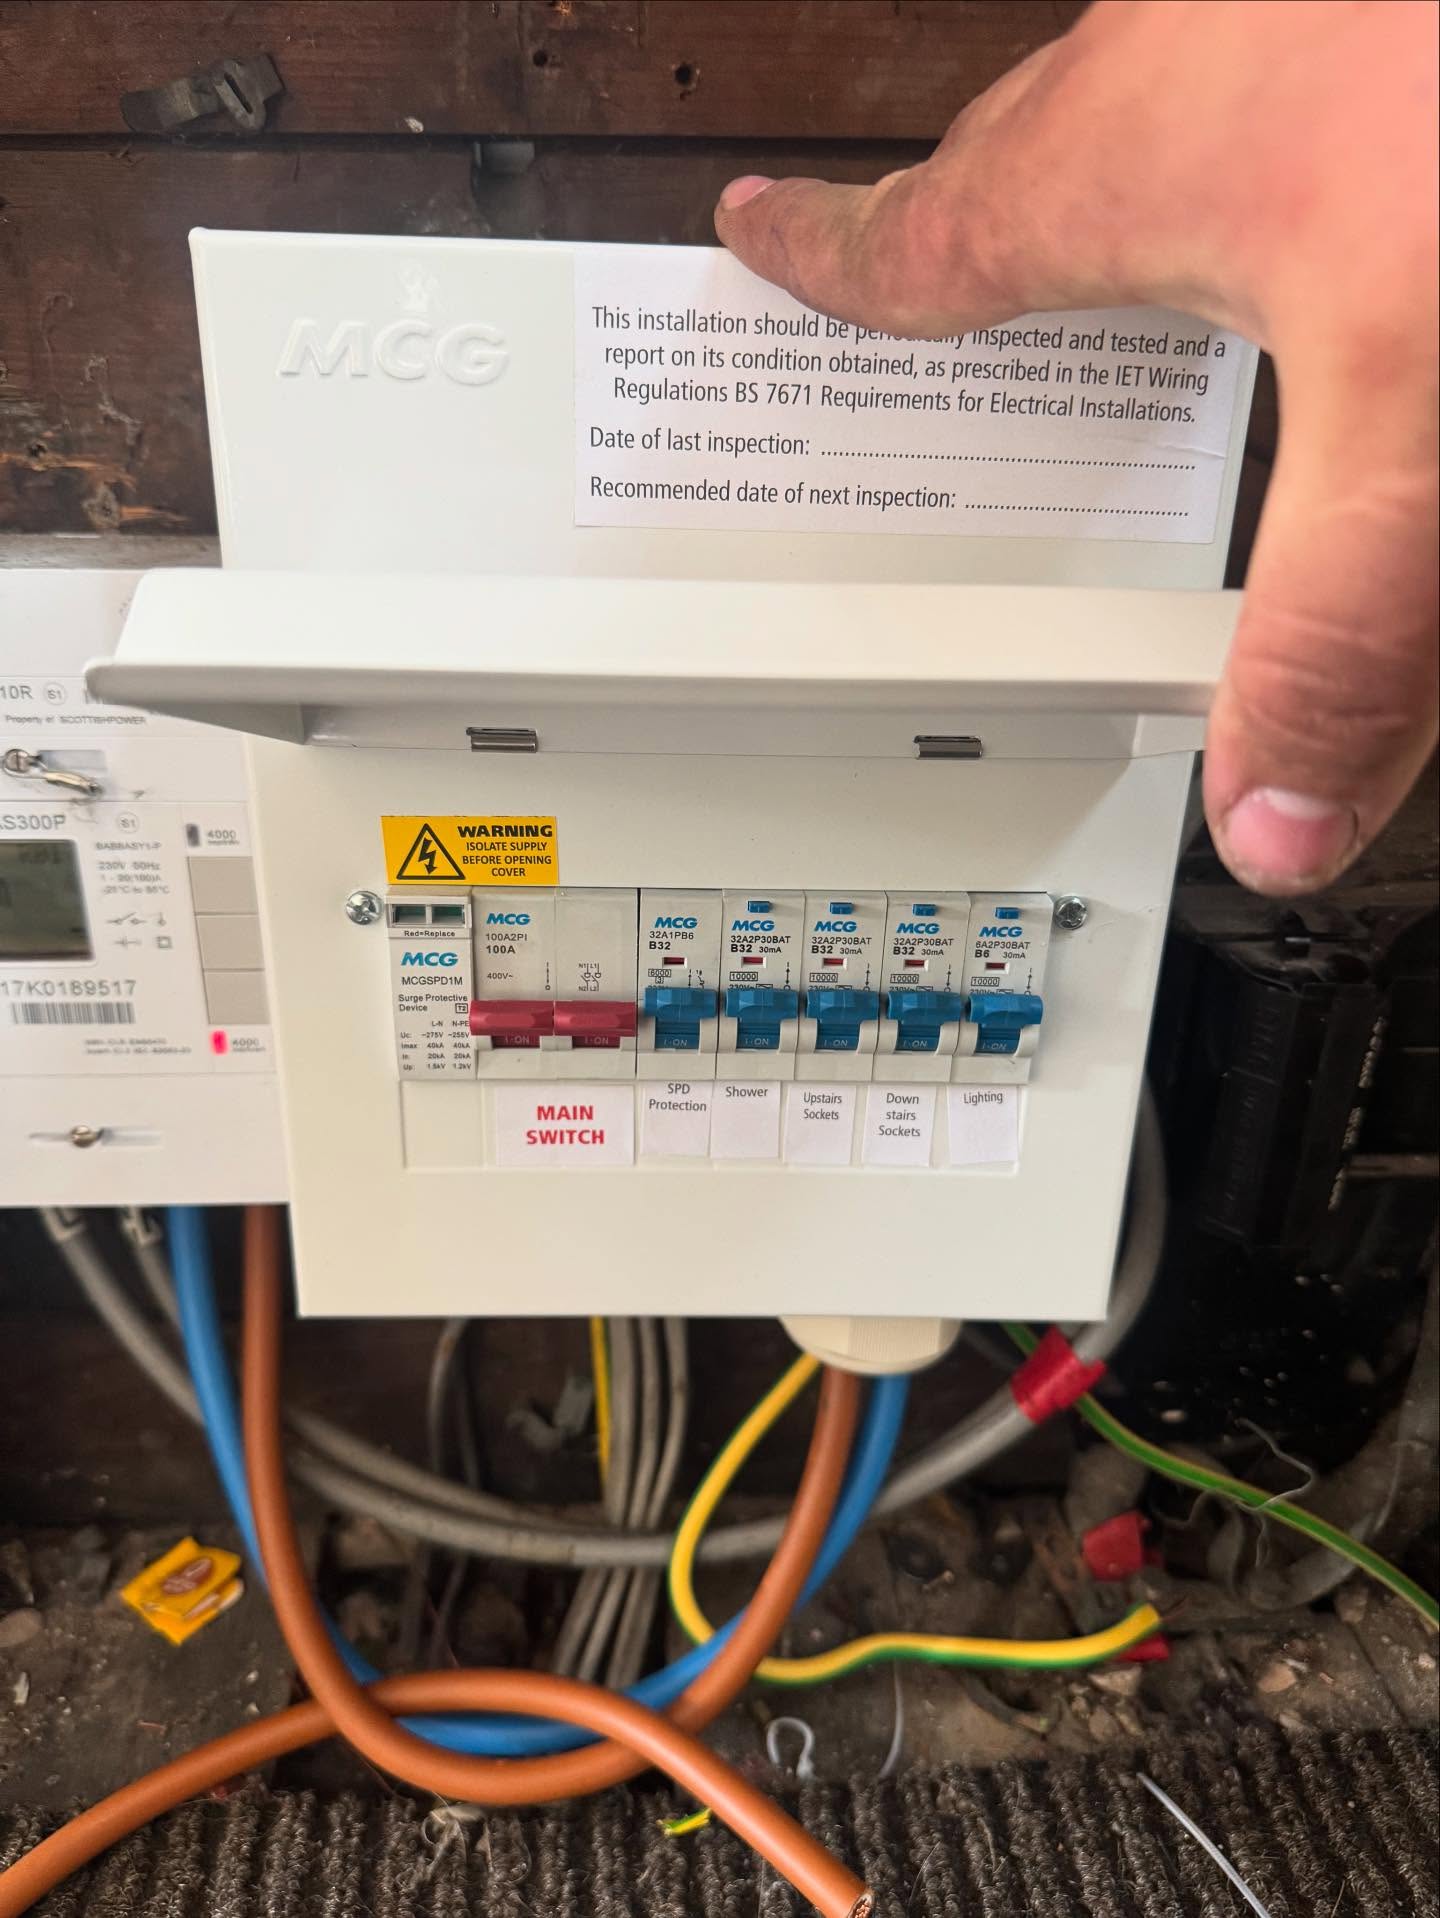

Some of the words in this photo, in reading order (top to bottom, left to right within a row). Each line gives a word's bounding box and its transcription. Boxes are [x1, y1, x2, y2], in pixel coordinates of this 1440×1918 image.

[592, 306, 630, 330] This
[638, 308, 746, 334] installation
[754, 312, 819, 337] should
[826, 314, 849, 338] be
[1069, 329, 1105, 350] and
[1111, 332, 1169, 354] tested
[1174, 335, 1209, 357] and
[1215, 341, 1225, 357] a
[276, 318, 510, 386] MCG
[605, 346, 664, 369] report
[672, 350, 695, 367] on
[703, 346, 724, 368] its
[732, 348, 821, 372] condition
[829, 350, 918, 379] obtained,
[925, 360, 945, 377] as
[952, 359, 1050, 383] prescribed
[1056, 362, 1072, 383] in
[1080, 362, 1108, 385] the
[1116, 365, 1144, 387] IET
[1149, 366, 1209, 396] Wiring
[614, 377, 728, 406] Regulations
[735, 382, 758, 403] BS
[767, 383, 811, 406] 7671
[821, 385, 950, 413] Requirements
[958, 390, 984, 412] for
[990, 392, 1073, 416] Electrical
[1080, 397, 1195, 423] Installations.
[590, 426, 635, 449] Date
[642, 428, 662, 450] of
[667, 428, 702, 452] last
[708, 431, 810, 458] inspection:
[591, 476, 730, 502] Recommended
[737, 480, 778, 503] date
[784, 482, 804, 504] of
[809, 485, 850, 506] next
[856, 486, 956, 511] inspection:
[0, 815, 66, 830] S300P
[458, 825, 552, 838] WARNING
[466, 842, 507, 851] ISOLATE
[510, 842, 547, 851] SUPPLY
[462, 856, 501, 865] BEFORE
[504, 856, 551, 865] OPENING
[492, 868, 526, 877] COVER
[486, 913, 531, 925] MCG
[655, 917, 698, 928] MCG
[732, 920, 775, 932] MCG
[814, 921, 857, 932] MCG
[896, 923, 939, 934] MCG
[979, 926, 1023, 937] MCG
[404, 930, 455, 938] Red=Replace
[649, 931, 694, 940] 32A1PB6
[730, 935, 791, 943] 32A2P30BAT
[649, 941, 671, 950] B32
[811, 936, 872, 945] 32A2P30BAT
[894, 938, 954, 946] 32A2P30BAT
[975, 941, 1030, 949] 6A2P30BAT
[486, 945, 516, 954] 100A
[730, 944, 752, 953] B32
[811, 945, 833, 954] B32
[893, 946, 915, 955] B32
[975, 949, 990, 958] B6
[1003, 951, 1026, 959] 30mA
[401, 952, 458, 966] MCG
[402, 976, 463, 985] MCGSPD1M
[399, 994, 423, 1003] Surge
[668, 1083, 690, 1094] SPD
[726, 1086, 768, 1098] Shower
[804, 1092, 842, 1105] Upstairs
[886, 1092, 919, 1105] Down
[963, 1091, 1003, 1106] Lighting
[649, 1099, 707, 1112] Protection
[537, 1106, 594, 1120] MAIN
[804, 1108, 839, 1120] Sockets
[886, 1109, 916, 1121] stairs
[878, 1125, 920, 1137] Sockets
[526, 1129, 604, 1145] SWITCH
